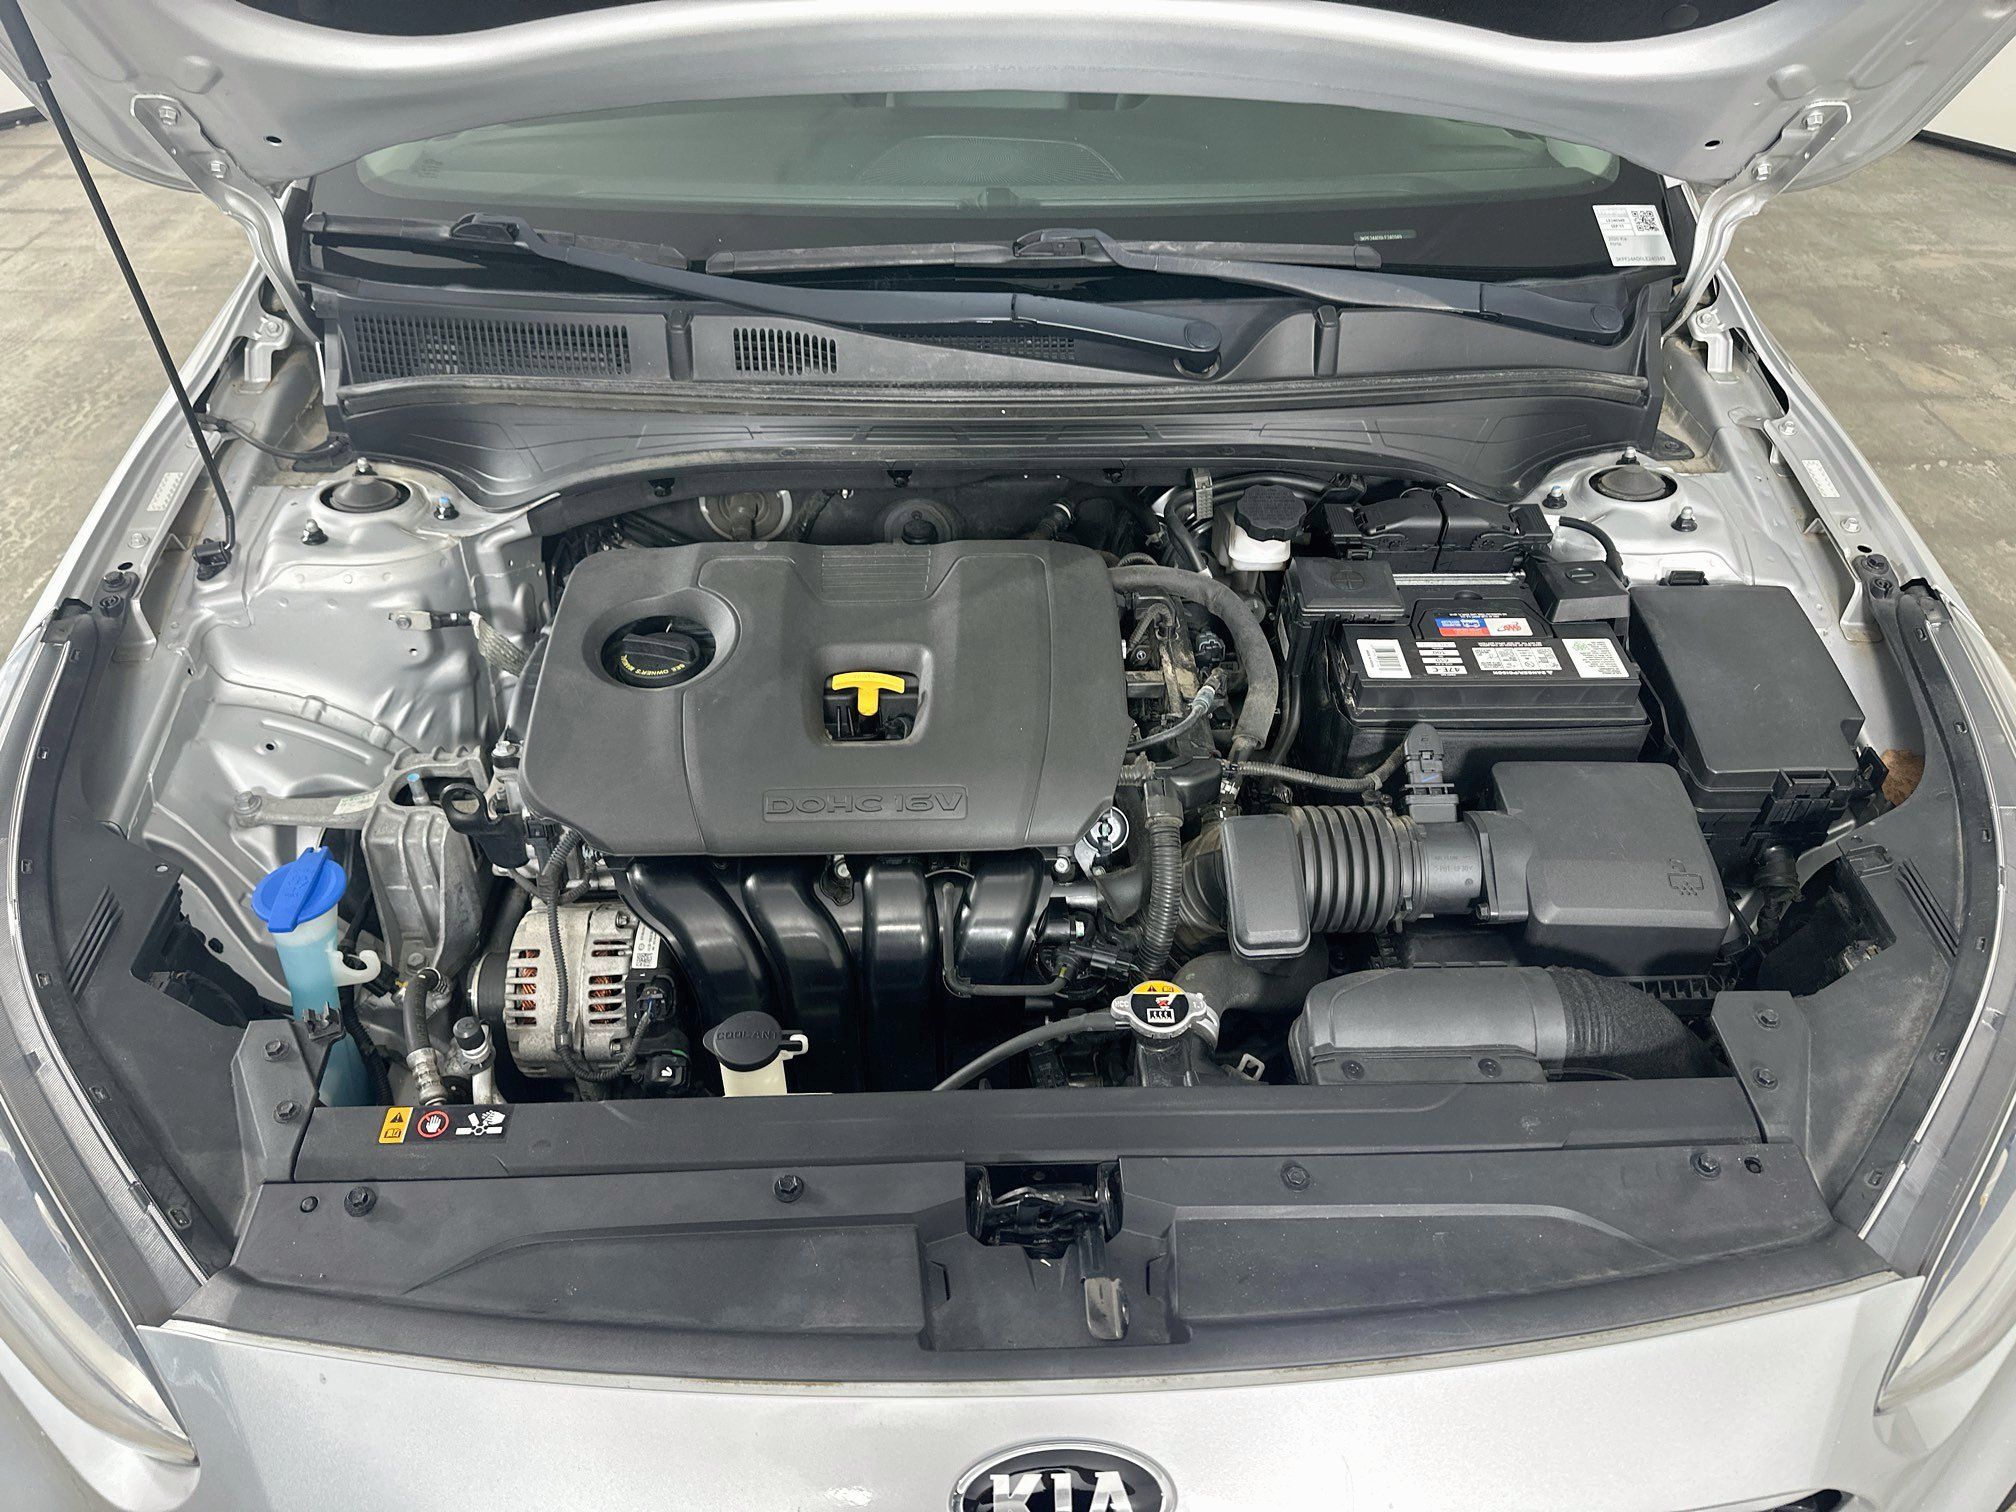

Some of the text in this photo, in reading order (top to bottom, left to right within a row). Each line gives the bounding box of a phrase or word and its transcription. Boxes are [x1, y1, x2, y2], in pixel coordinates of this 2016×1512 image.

[671, 663, 685, 673] SEE
[766, 792, 964, 815] DOHC 16V
[717, 1030, 777, 1040] COOLANT
[989, 1471, 1135, 1512] KIA
